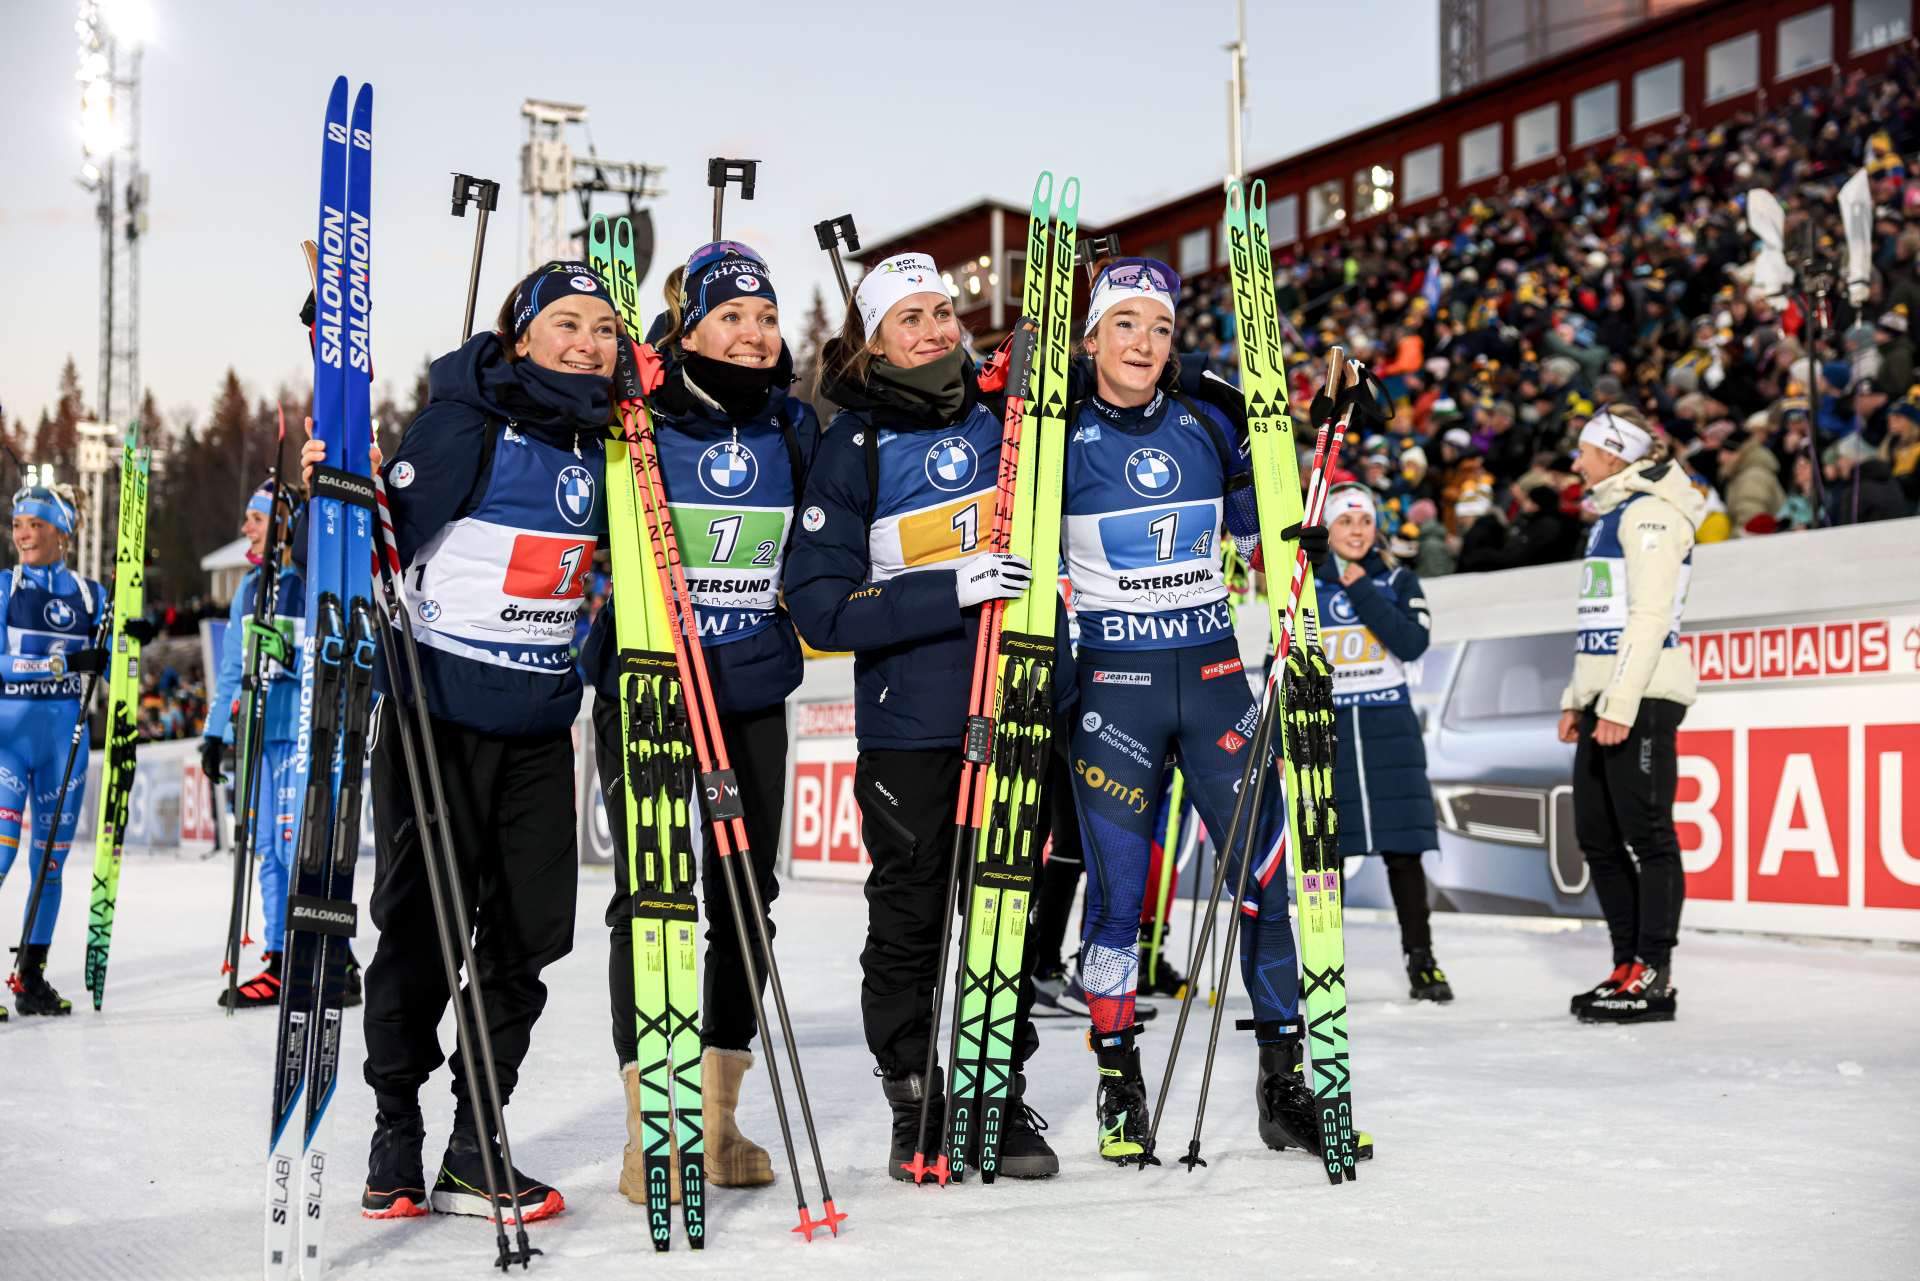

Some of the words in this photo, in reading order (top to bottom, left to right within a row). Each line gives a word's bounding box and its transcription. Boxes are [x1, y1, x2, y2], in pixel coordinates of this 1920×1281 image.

[896, 257, 917, 267] ROY
[321, 205, 344, 369] SALOMON
[350, 211, 369, 374] SALOMON
[1051, 220, 1074, 379] FISCHER
[1231, 225, 1262, 378] FISCHER
[1254, 222, 1282, 377] FISCHER
[1020, 369, 1030, 396] ONE
[1025, 334, 1035, 363] WAY
[1254, 421, 1269, 433] 63
[1275, 419, 1288, 432] 63
[707, 444, 751, 460] BMW
[930, 440, 967, 460] BMW
[1130, 450, 1169, 466] BMW
[318, 475, 374, 498] SALOMON
[561, 469, 594, 485] BMW
[122, 446, 134, 540] FISCHER
[133, 471, 146, 565] FISCHER
[952, 501, 979, 553] 1
[707, 514, 744, 564] 1
[752, 540, 776, 566] 2
[1148, 511, 1180, 563] 1
[1192, 530, 1212, 555] 4
[552, 544, 585, 596] 1
[1118, 568, 1214, 591] ÖSTERSUND
[674, 578, 771, 594] TERSUND
[847, 586, 883, 602] mfy
[1102, 613, 1188, 642] BMW
[1194, 601, 1231, 635] iX3
[1006, 640, 1055, 652] FISCHER
[1323, 631, 1364, 661] 10
[1105, 673, 1128, 682] Jean
[1129, 674, 1150, 682] Lain
[296, 636, 315, 774] SALOMON
[1098, 731, 1153, 769] Rhône-Alpes
[1104, 723, 1150, 754] Auvergne-
[875, 780, 895, 802] CRAFT
[1074, 758, 1150, 814] somfy
[983, 871, 1032, 882] FISCHER
[292, 906, 355, 925] SALOMON
[640, 900, 696, 911] FISCHER
